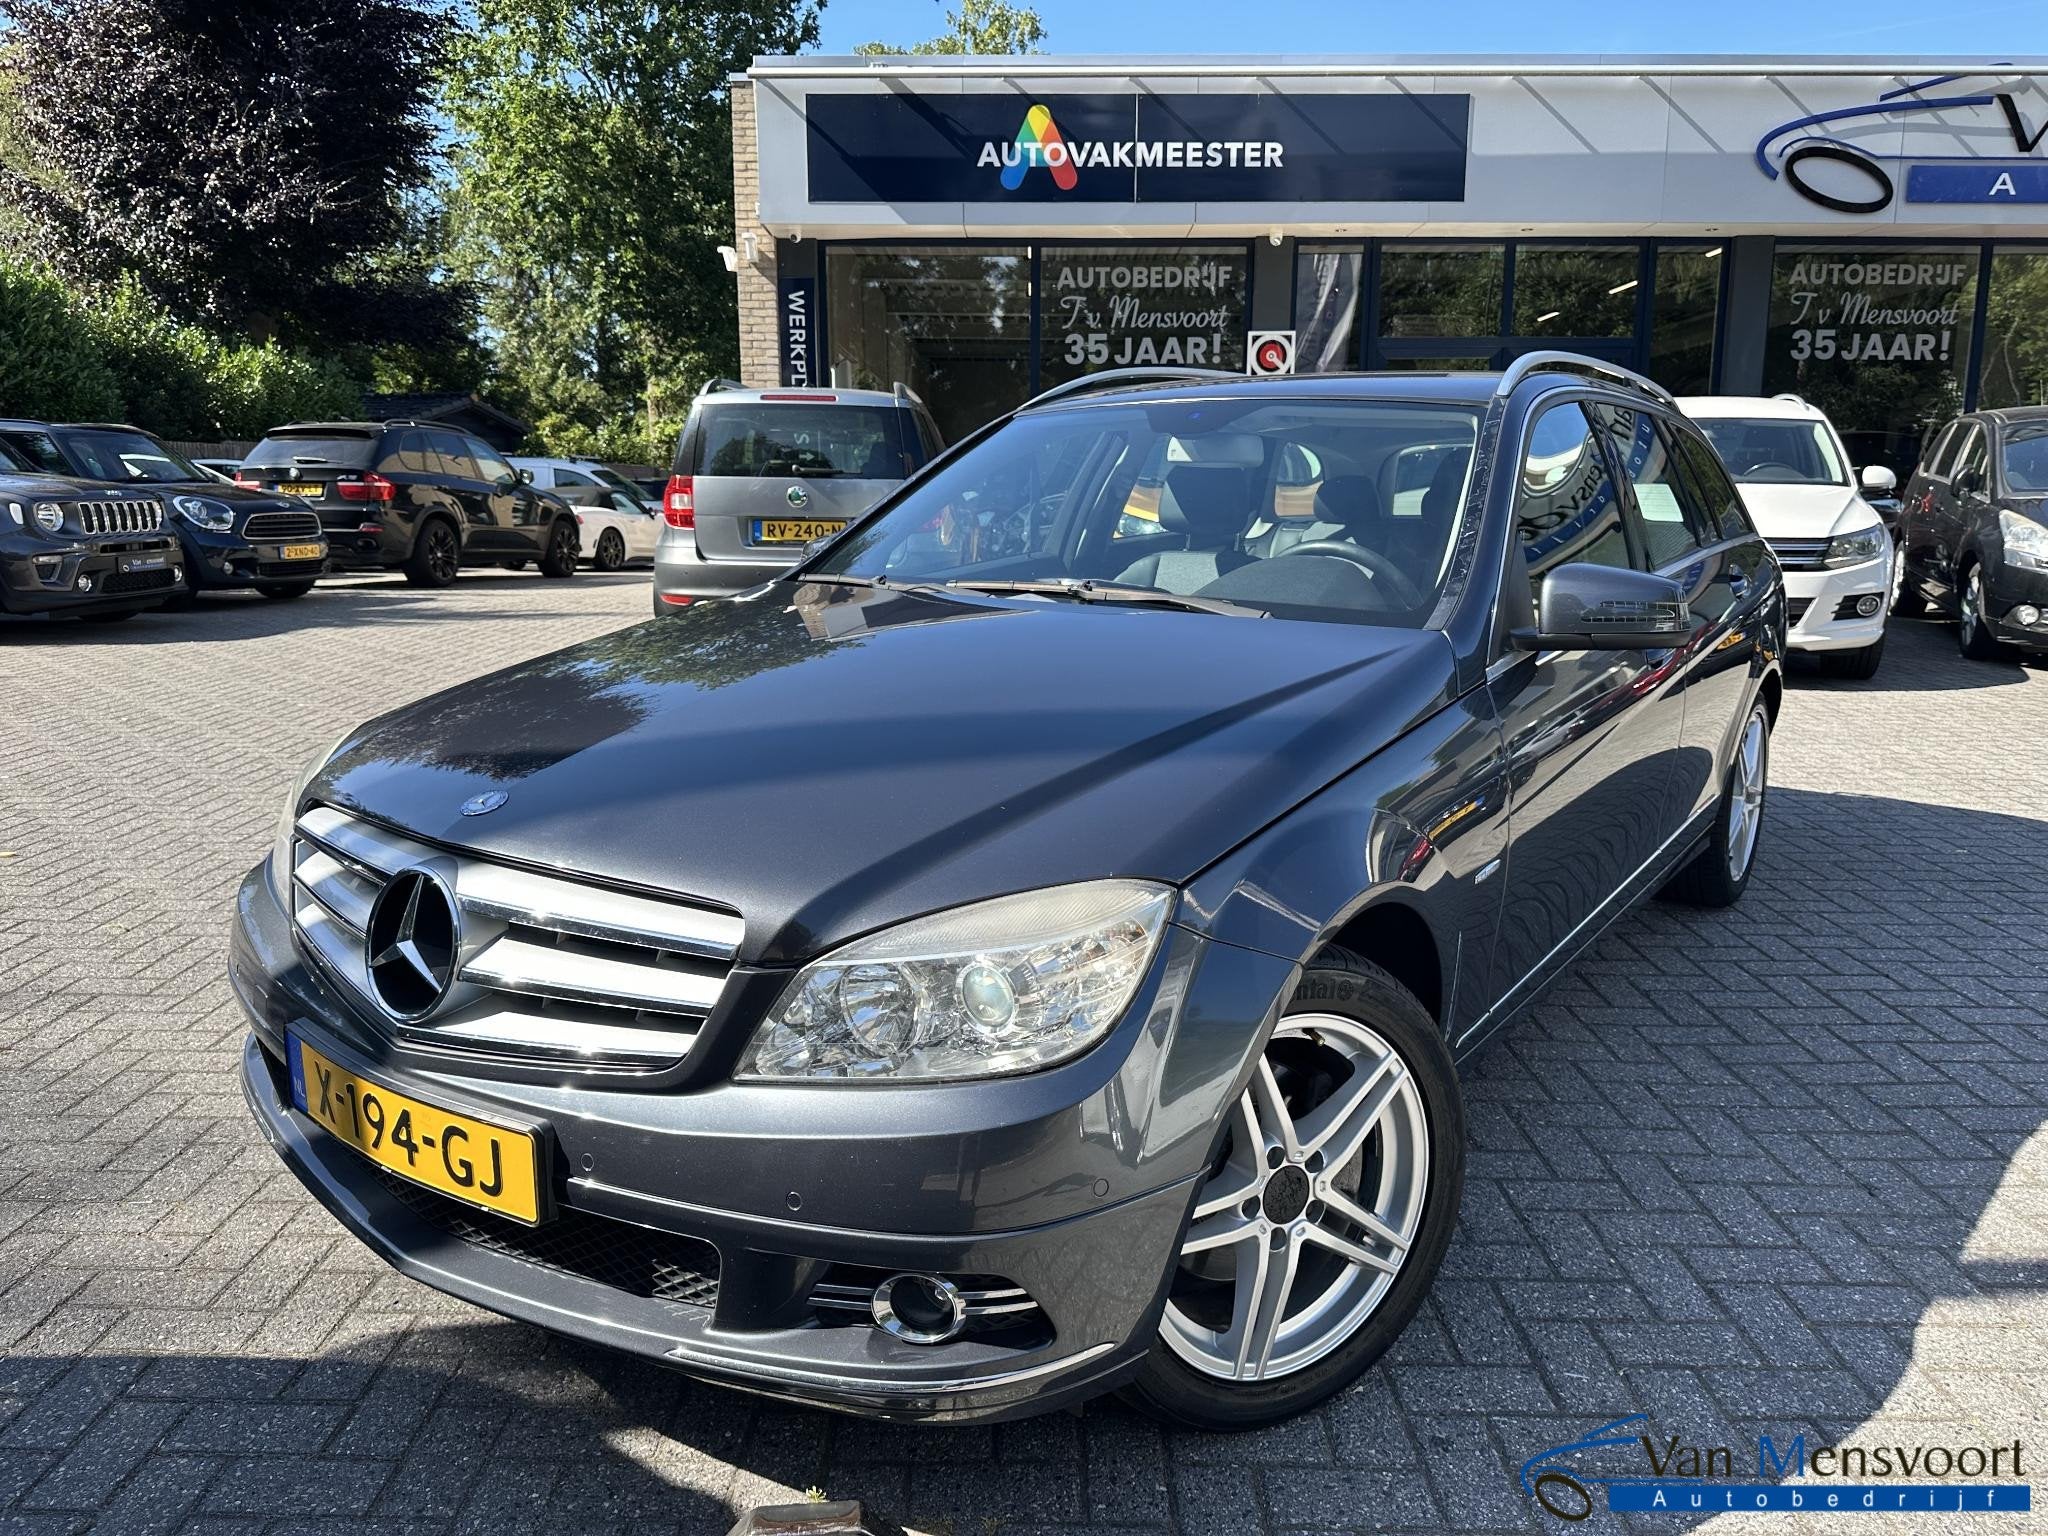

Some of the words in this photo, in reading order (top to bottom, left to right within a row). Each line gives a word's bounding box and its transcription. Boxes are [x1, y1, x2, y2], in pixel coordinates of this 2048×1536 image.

[977, 141, 1283, 168] AUTOVAKMEESTER
[1057, 266, 1232, 288] AUTOBEDRIJF
[1789, 264, 1967, 285] AUTOBEDRIJF
[1109, 295, 1231, 329] Mensvoort
[1840, 291, 1960, 325] Mensvoort
[1064, 333, 1109, 364] 35
[1114, 333, 1221, 364] JAAR!
[1790, 329, 1836, 360] 35
[1840, 331, 1951, 361] JAAR!
[767, 523, 841, 538] RV-240-N
[293, 1079, 306, 1098] NL
[314, 1060, 504, 1197] X-194-GJ
